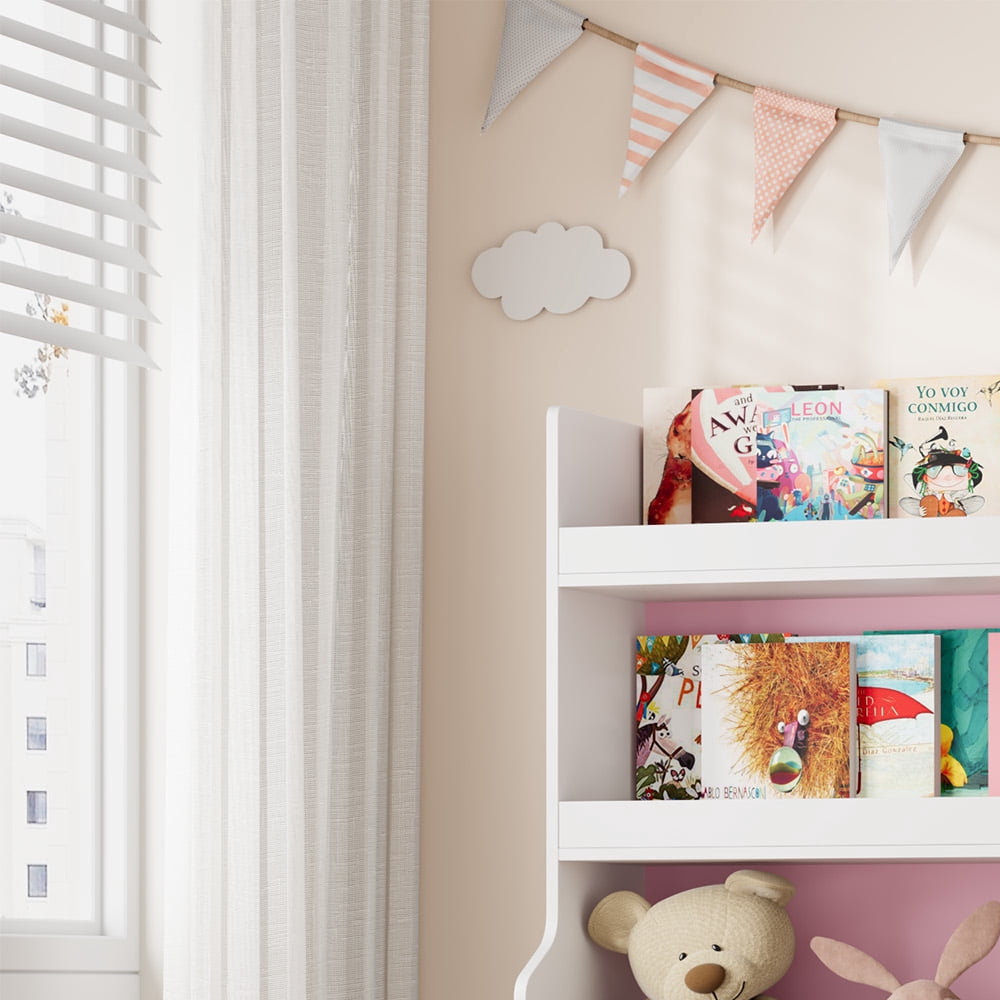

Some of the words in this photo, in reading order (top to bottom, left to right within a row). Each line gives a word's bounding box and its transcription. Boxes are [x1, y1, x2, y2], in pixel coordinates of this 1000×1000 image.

[735, 393, 753, 406] and
[791, 401, 842, 416] LEON
[908, 401, 978, 413] CONMIGO
